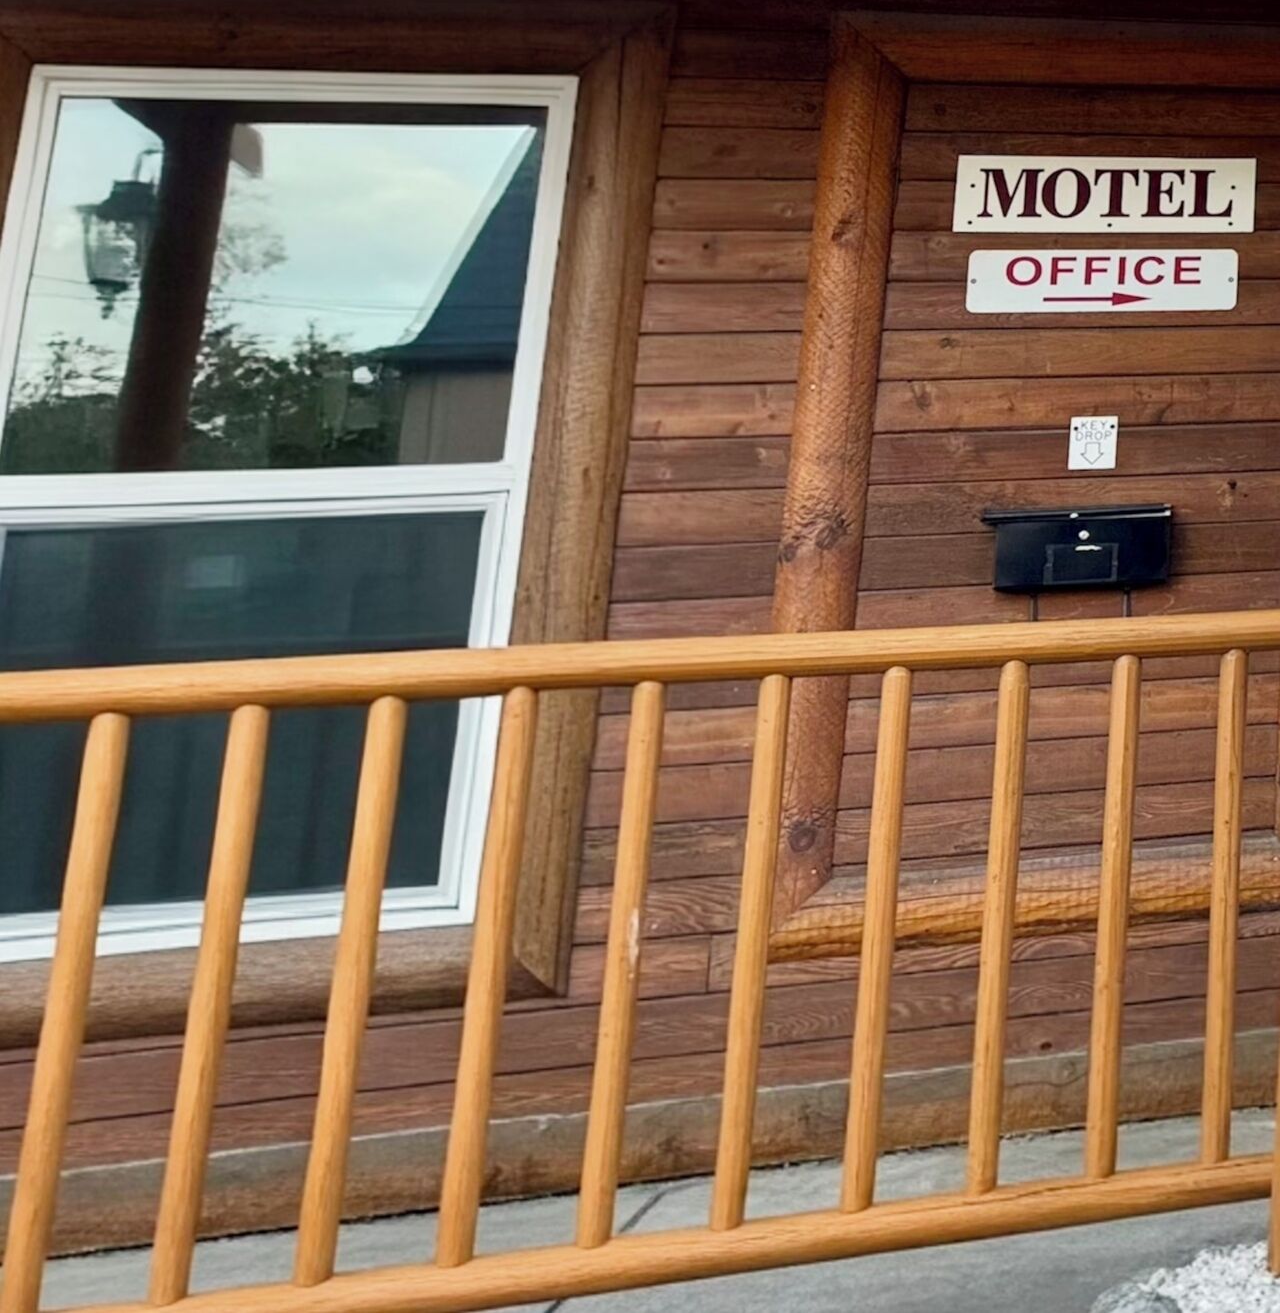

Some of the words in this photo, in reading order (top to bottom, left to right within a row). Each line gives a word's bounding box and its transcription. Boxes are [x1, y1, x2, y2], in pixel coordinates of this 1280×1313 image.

[976, 167, 1234, 219] MOTEL
[1005, 255, 1202, 287] OFFICE
[1075, 430, 1112, 441] DROP
[1080, 420, 1108, 430] KEY
